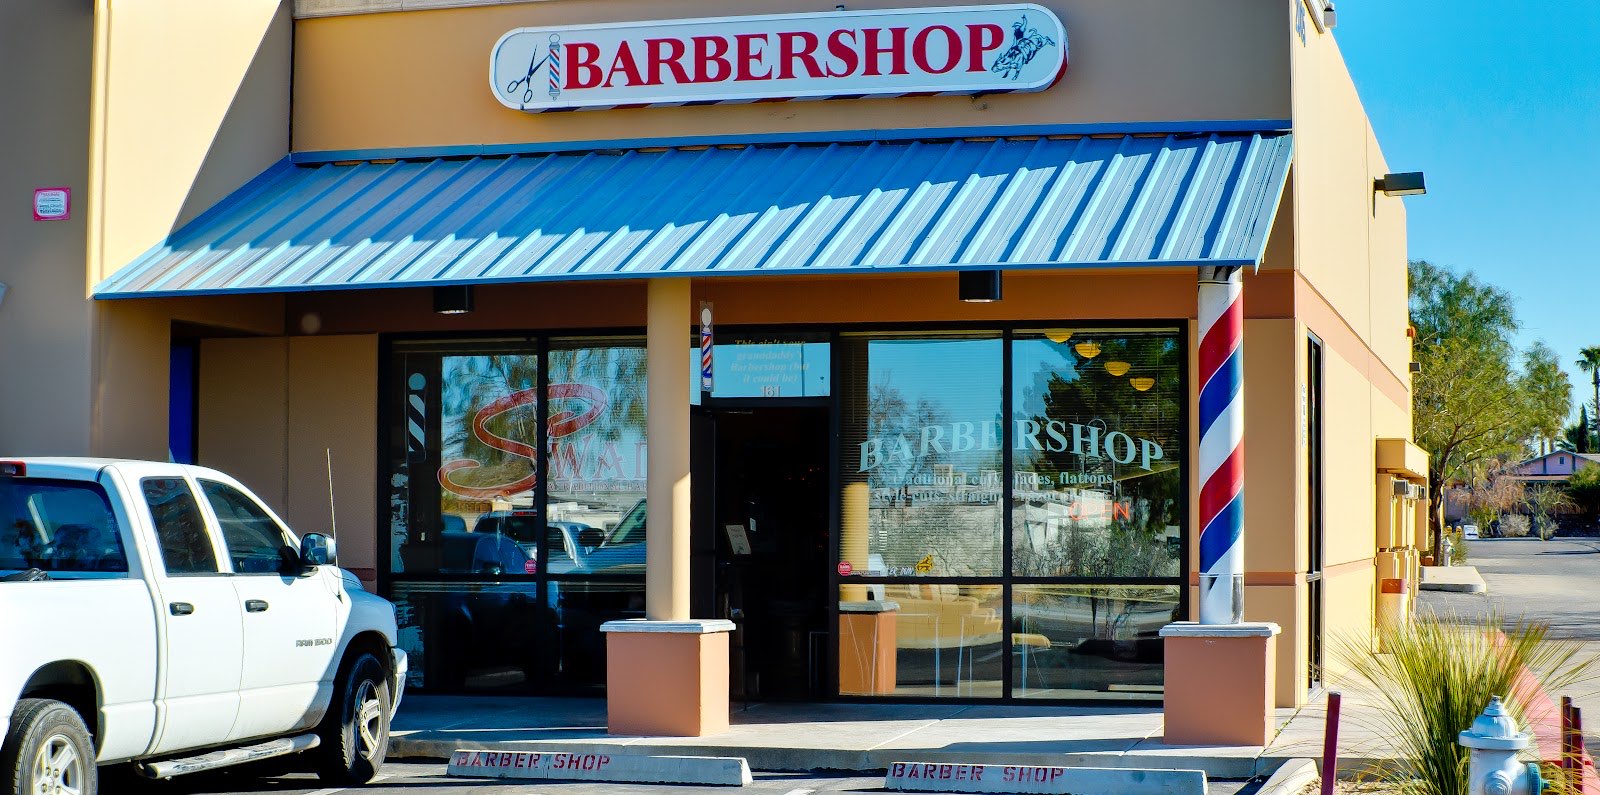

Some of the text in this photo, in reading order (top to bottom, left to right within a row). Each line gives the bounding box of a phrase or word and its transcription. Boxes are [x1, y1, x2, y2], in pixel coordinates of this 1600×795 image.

[562, 24, 1004, 90] BARBERSHOP
[762, 385, 781, 397] 161
[857, 418, 1164, 474] BARBERSHOP
[1014, 471, 1055, 486] fades,
[1069, 501, 1130, 521] OPEN
[456, 751, 611, 771] BARBER SHOP
[891, 762, 1064, 783] BARBER SHOP
